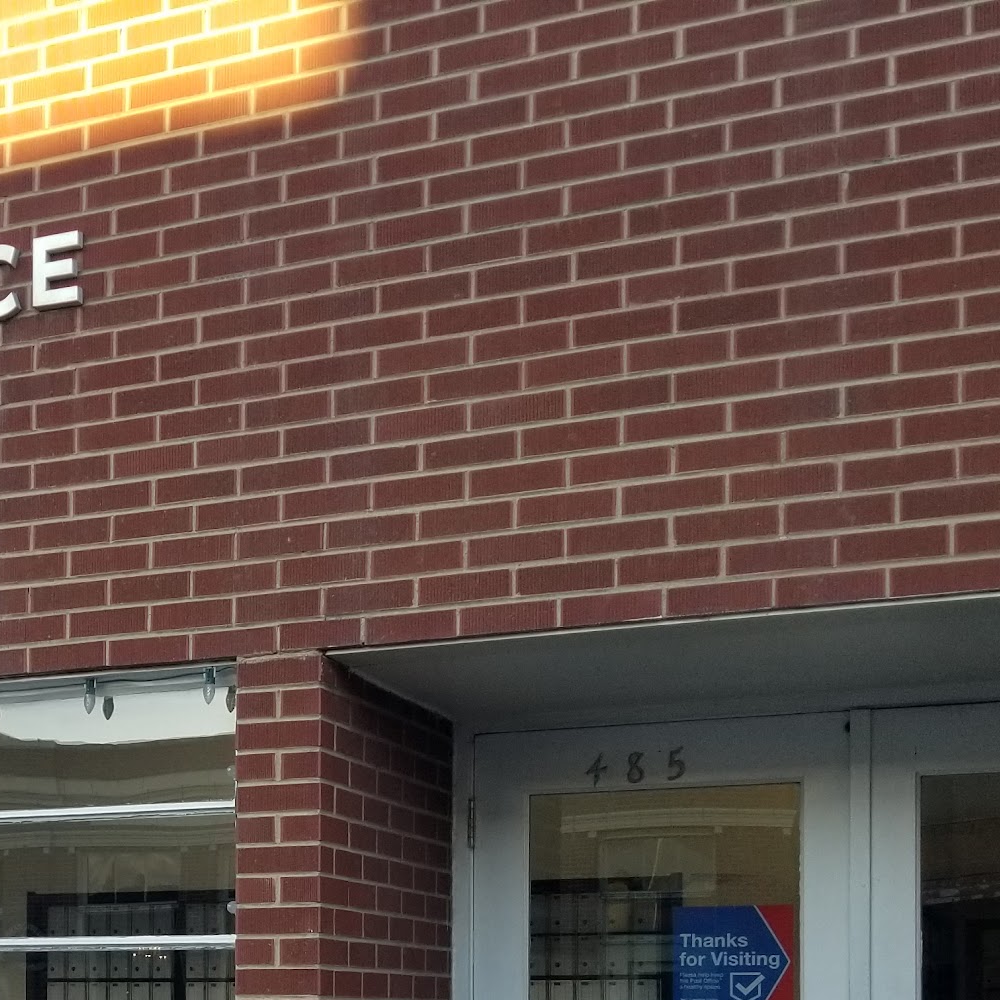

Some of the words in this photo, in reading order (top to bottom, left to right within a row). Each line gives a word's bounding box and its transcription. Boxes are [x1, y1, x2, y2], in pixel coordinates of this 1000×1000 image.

[585, 745, 686, 788] 485
[679, 932, 749, 948] Thanks
[679, 951, 706, 967] for
[710, 951, 781, 970] Visiting
